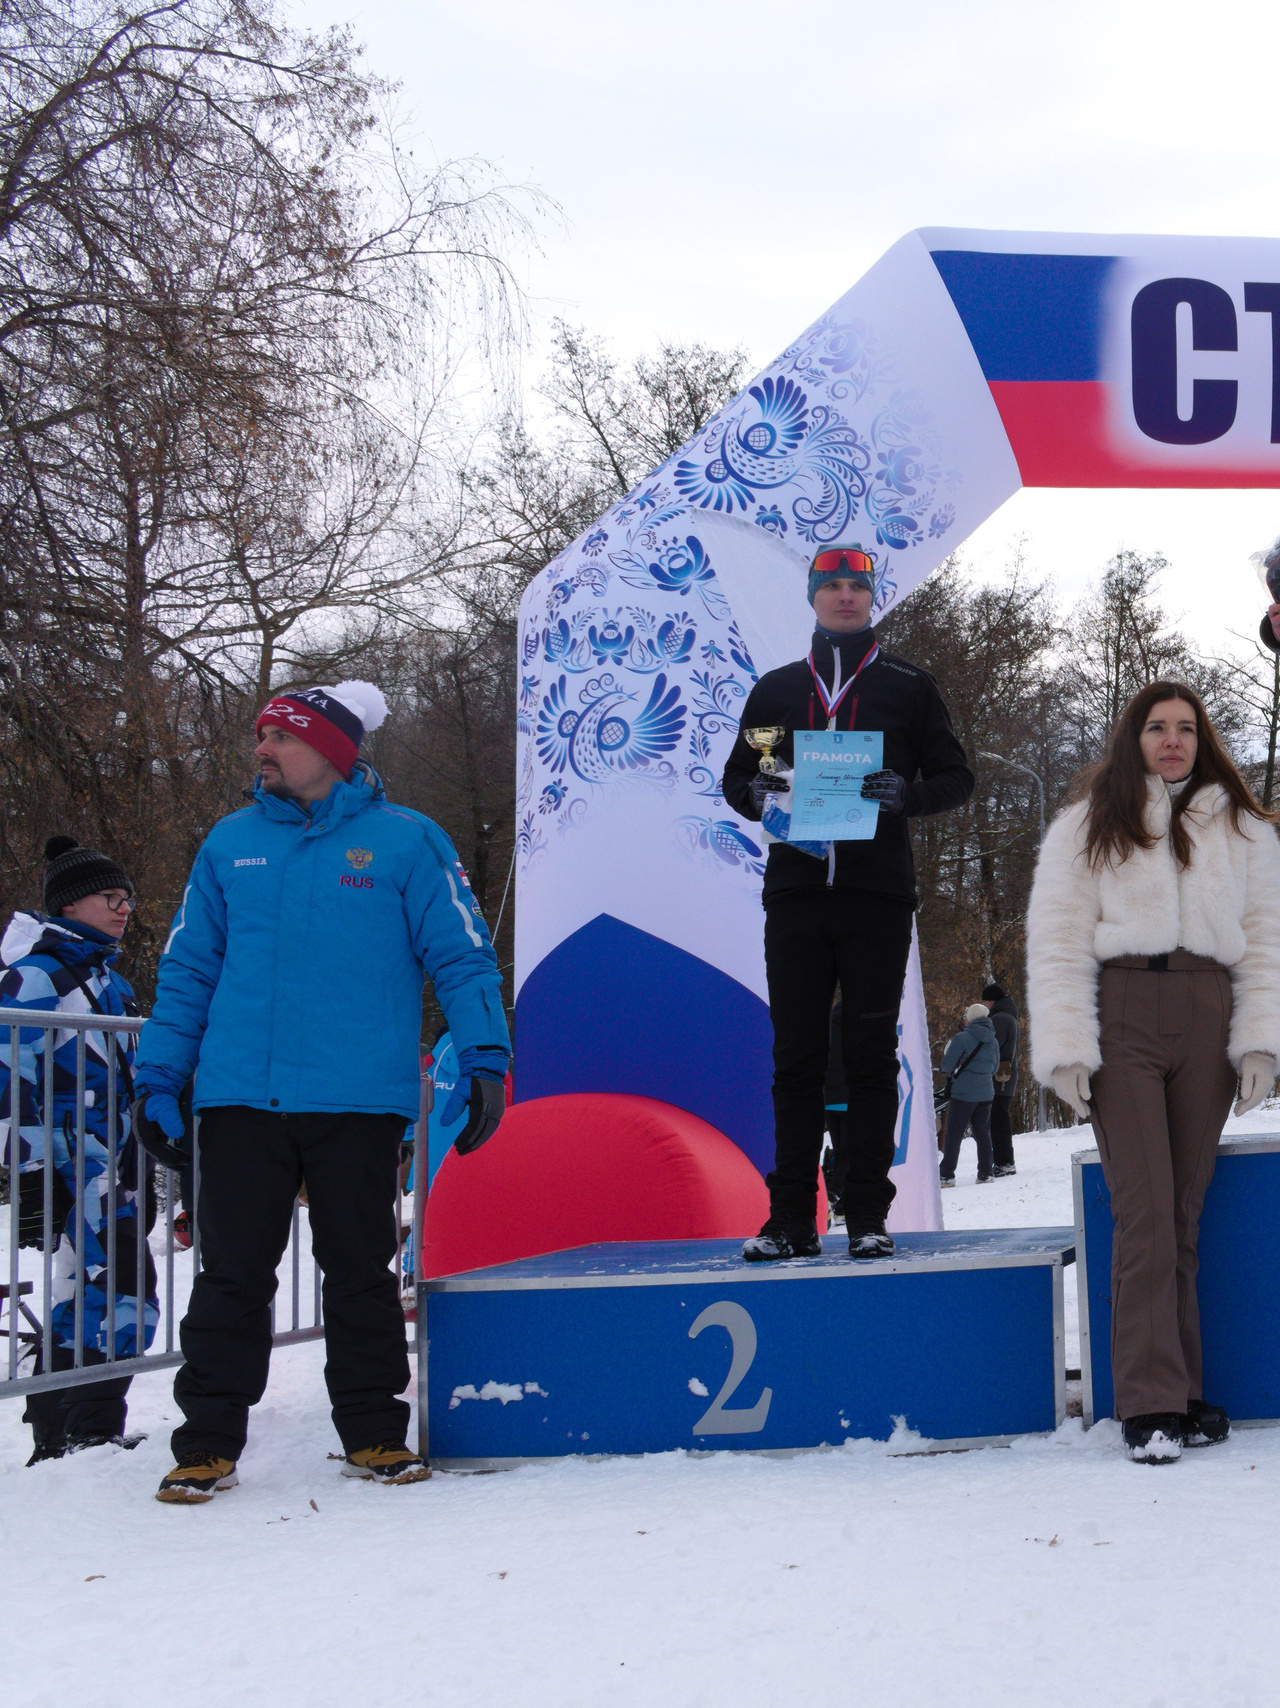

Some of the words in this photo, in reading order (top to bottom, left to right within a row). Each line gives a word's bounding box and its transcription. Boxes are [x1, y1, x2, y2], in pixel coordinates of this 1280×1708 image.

[802, 751, 873, 764] ГРАМОТА
[233, 857, 268, 868] RUSSIA
[339, 875, 374, 889] RUS
[434, 1081, 456, 1091] RU
[687, 1300, 774, 1437] 2
